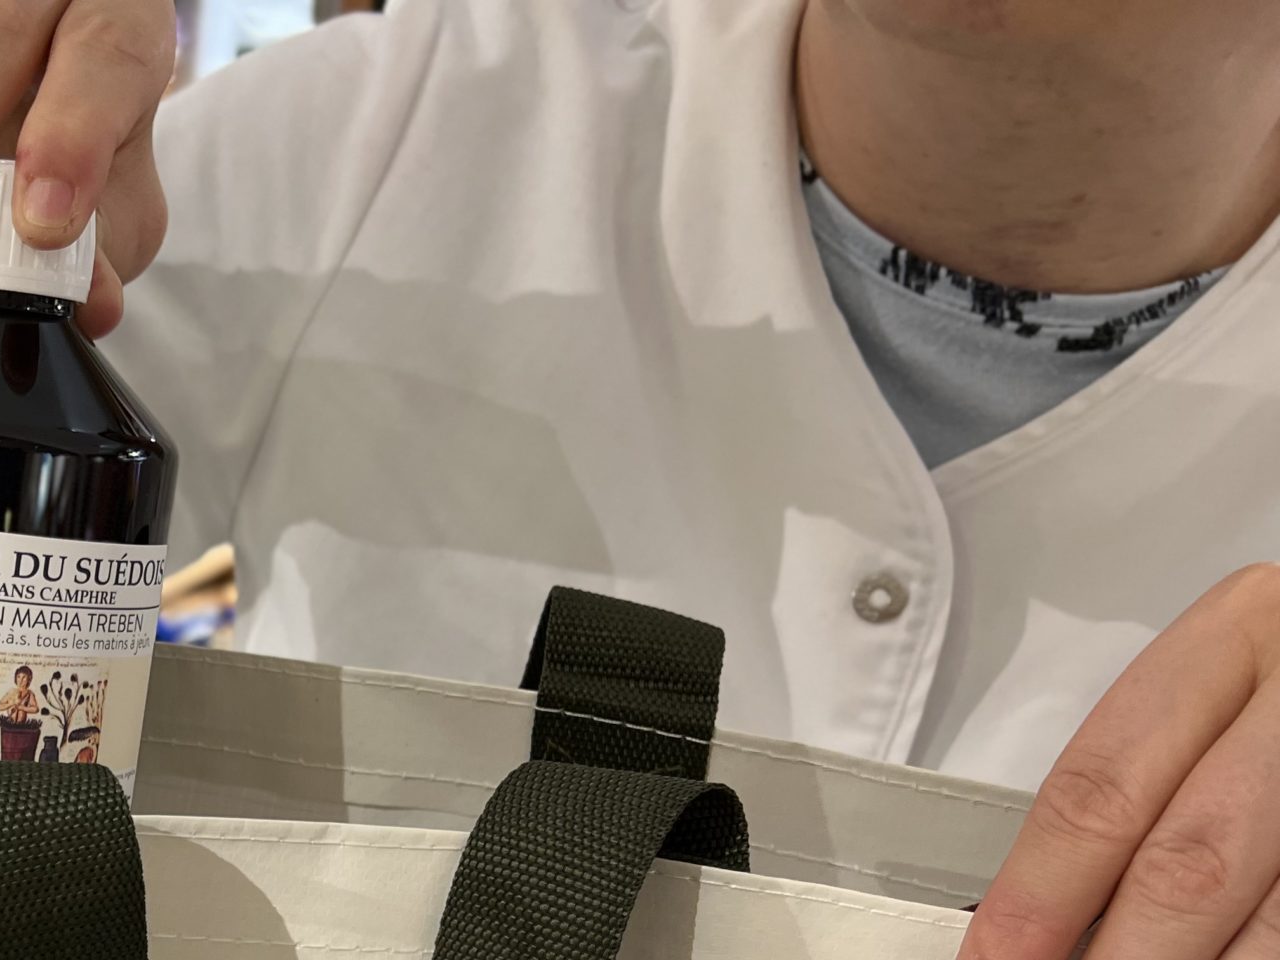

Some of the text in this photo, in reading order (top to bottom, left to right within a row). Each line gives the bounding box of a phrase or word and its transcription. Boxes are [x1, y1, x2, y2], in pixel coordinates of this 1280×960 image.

[11, 551, 68, 582] DU
[73, 552, 165, 587] SUÉDOIS
[39, 586, 117, 605] CAMPHRE
[11, 607, 82, 632] MARIA
[87, 613, 144, 633] TREBEN
[36, 633, 68, 648] tous
[72, 633, 90, 650] les
[93, 633, 128, 651] matins
